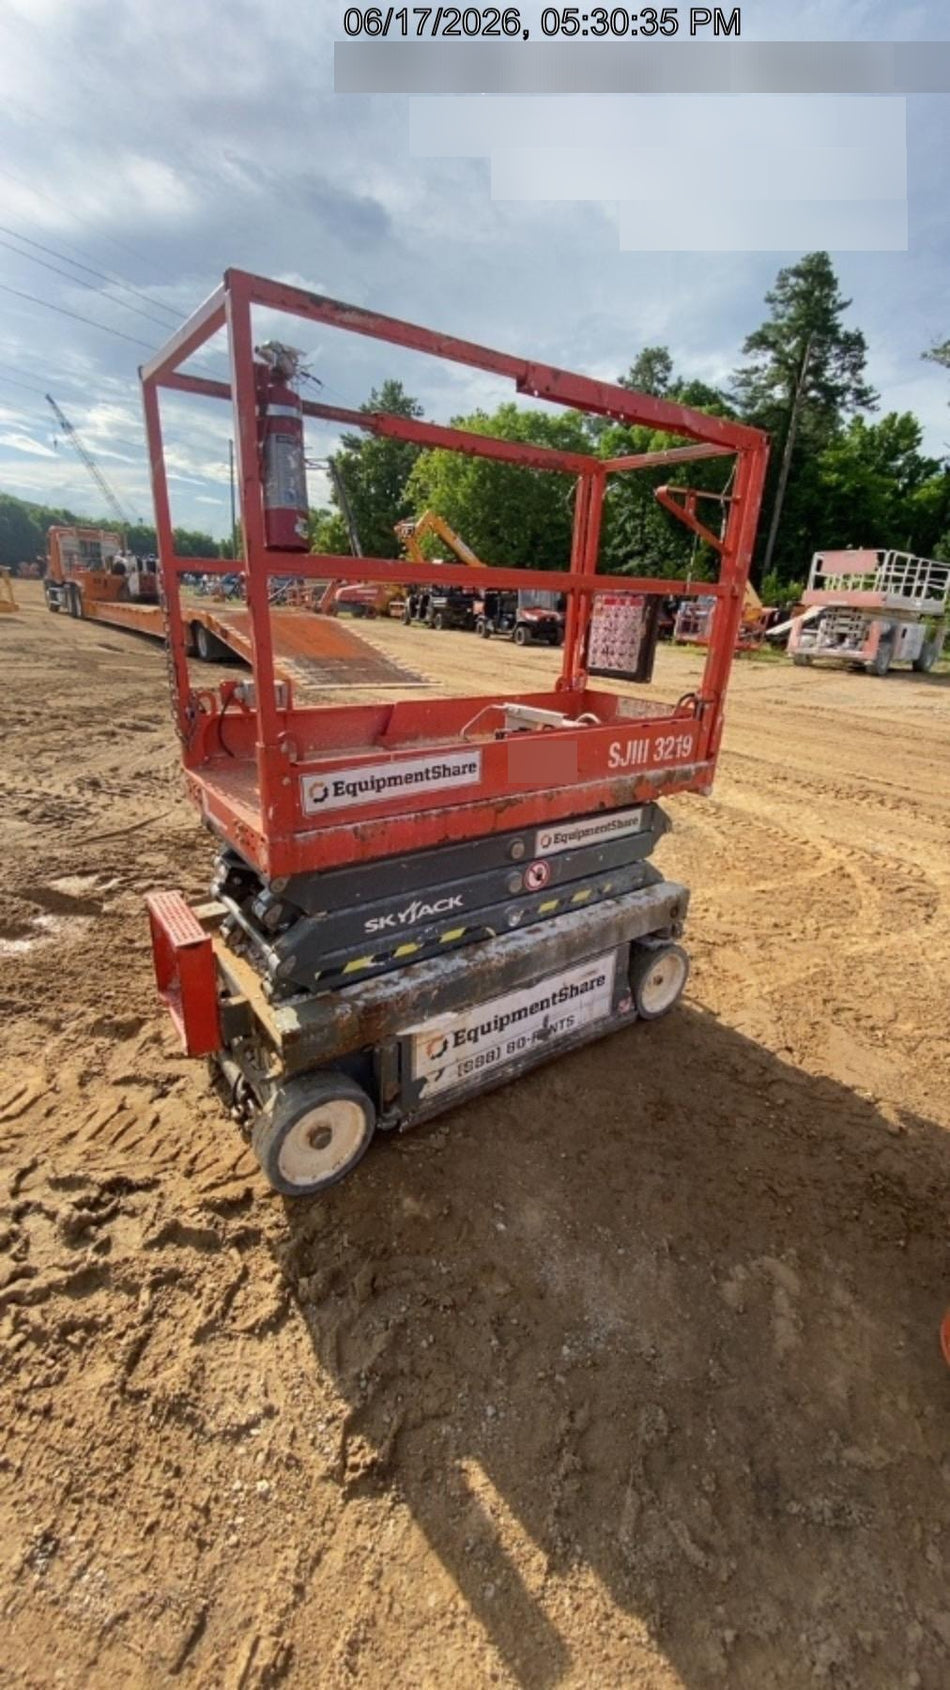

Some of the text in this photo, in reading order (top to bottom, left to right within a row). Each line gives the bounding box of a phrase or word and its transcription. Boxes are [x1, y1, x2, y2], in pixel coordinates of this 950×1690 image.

[653, 734, 693, 762] 3219
[332, 761, 477, 797] EquipmentShare
[553, 816, 639, 844] EquipmentShare
[364, 894, 464, 934] SKYJACK
[452, 974, 606, 1048] EquipmentShare
[506, 1015, 575, 1054] 80-RNTS
